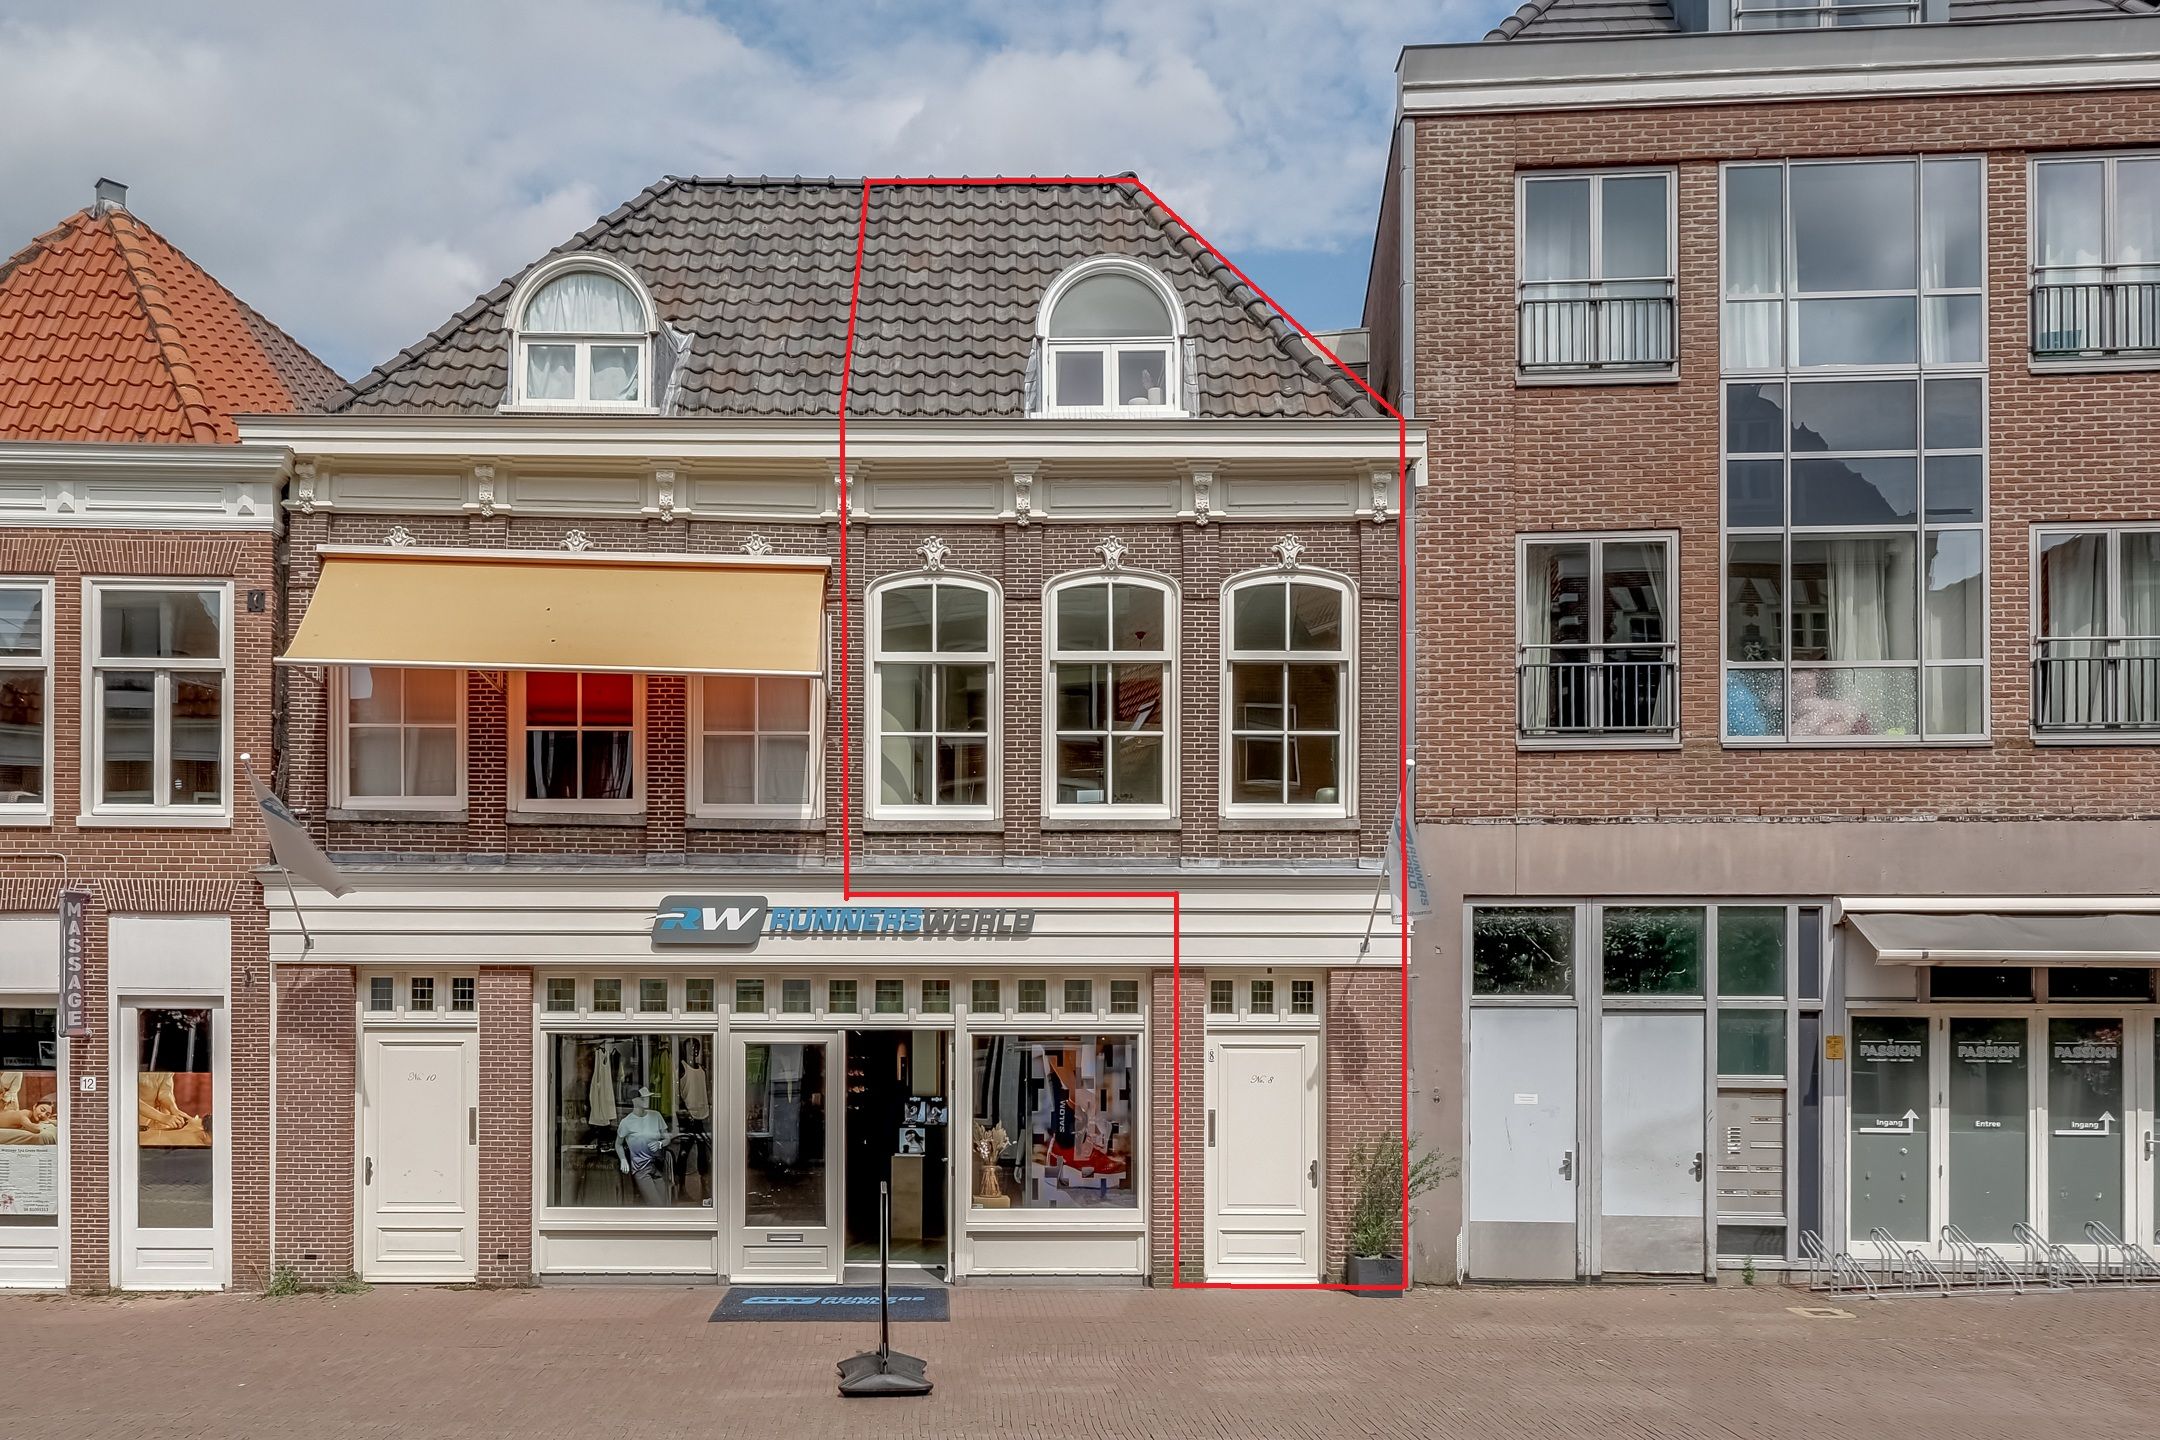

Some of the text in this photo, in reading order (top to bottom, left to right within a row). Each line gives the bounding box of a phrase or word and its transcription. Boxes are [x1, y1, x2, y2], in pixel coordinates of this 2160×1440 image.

[1407, 844, 1430, 907] RUNNERS
[656, 906, 760, 931] RW
[67, 901, 82, 1026] MASSAGE
[1860, 1044, 1921, 1057] PASSION
[1958, 1045, 2020, 1058] PASSION
[2054, 1046, 2117, 1059] PASSION
[426, 1073, 437, 1082] 10
[1267, 1076, 1275, 1084] 8
[83, 1078, 94, 1090] 12
[1876, 1119, 1904, 1128] Ingang
[1975, 1120, 2002, 1128] Entree
[2071, 1121, 2099, 1130] Ingang
